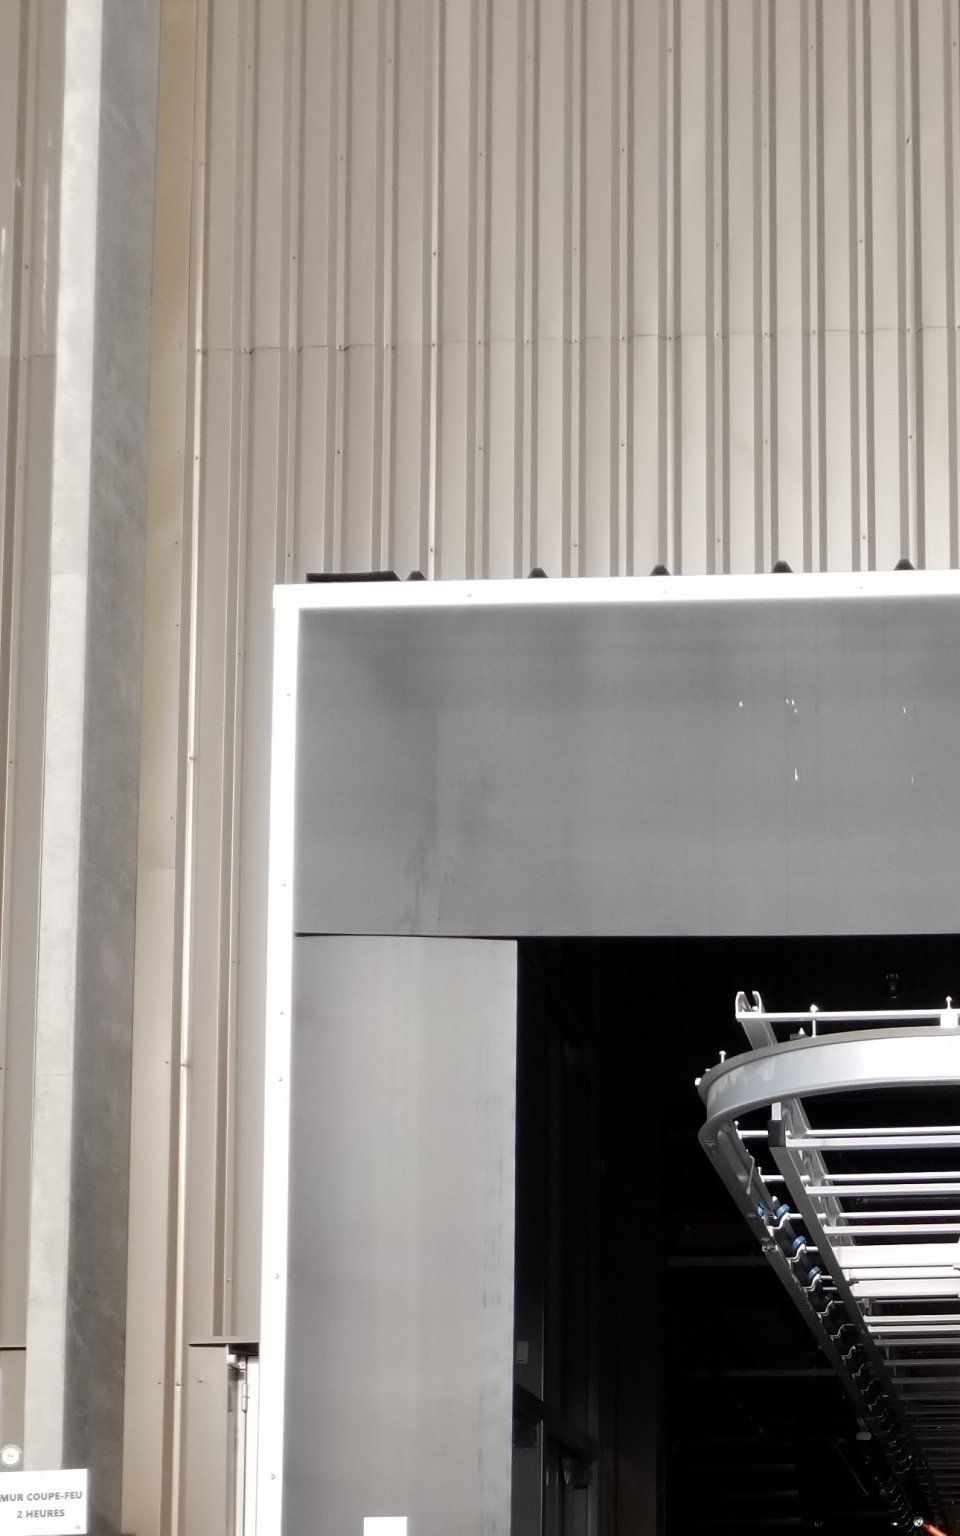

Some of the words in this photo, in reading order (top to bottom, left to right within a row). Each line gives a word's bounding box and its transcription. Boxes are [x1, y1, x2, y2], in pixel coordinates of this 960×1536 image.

[0, 1493, 24, 1502] MUR
[26, 1491, 83, 1501] COUPE-FEU
[16, 1510, 23, 1519] 2
[25, 1509, 65, 1518] HEURES
